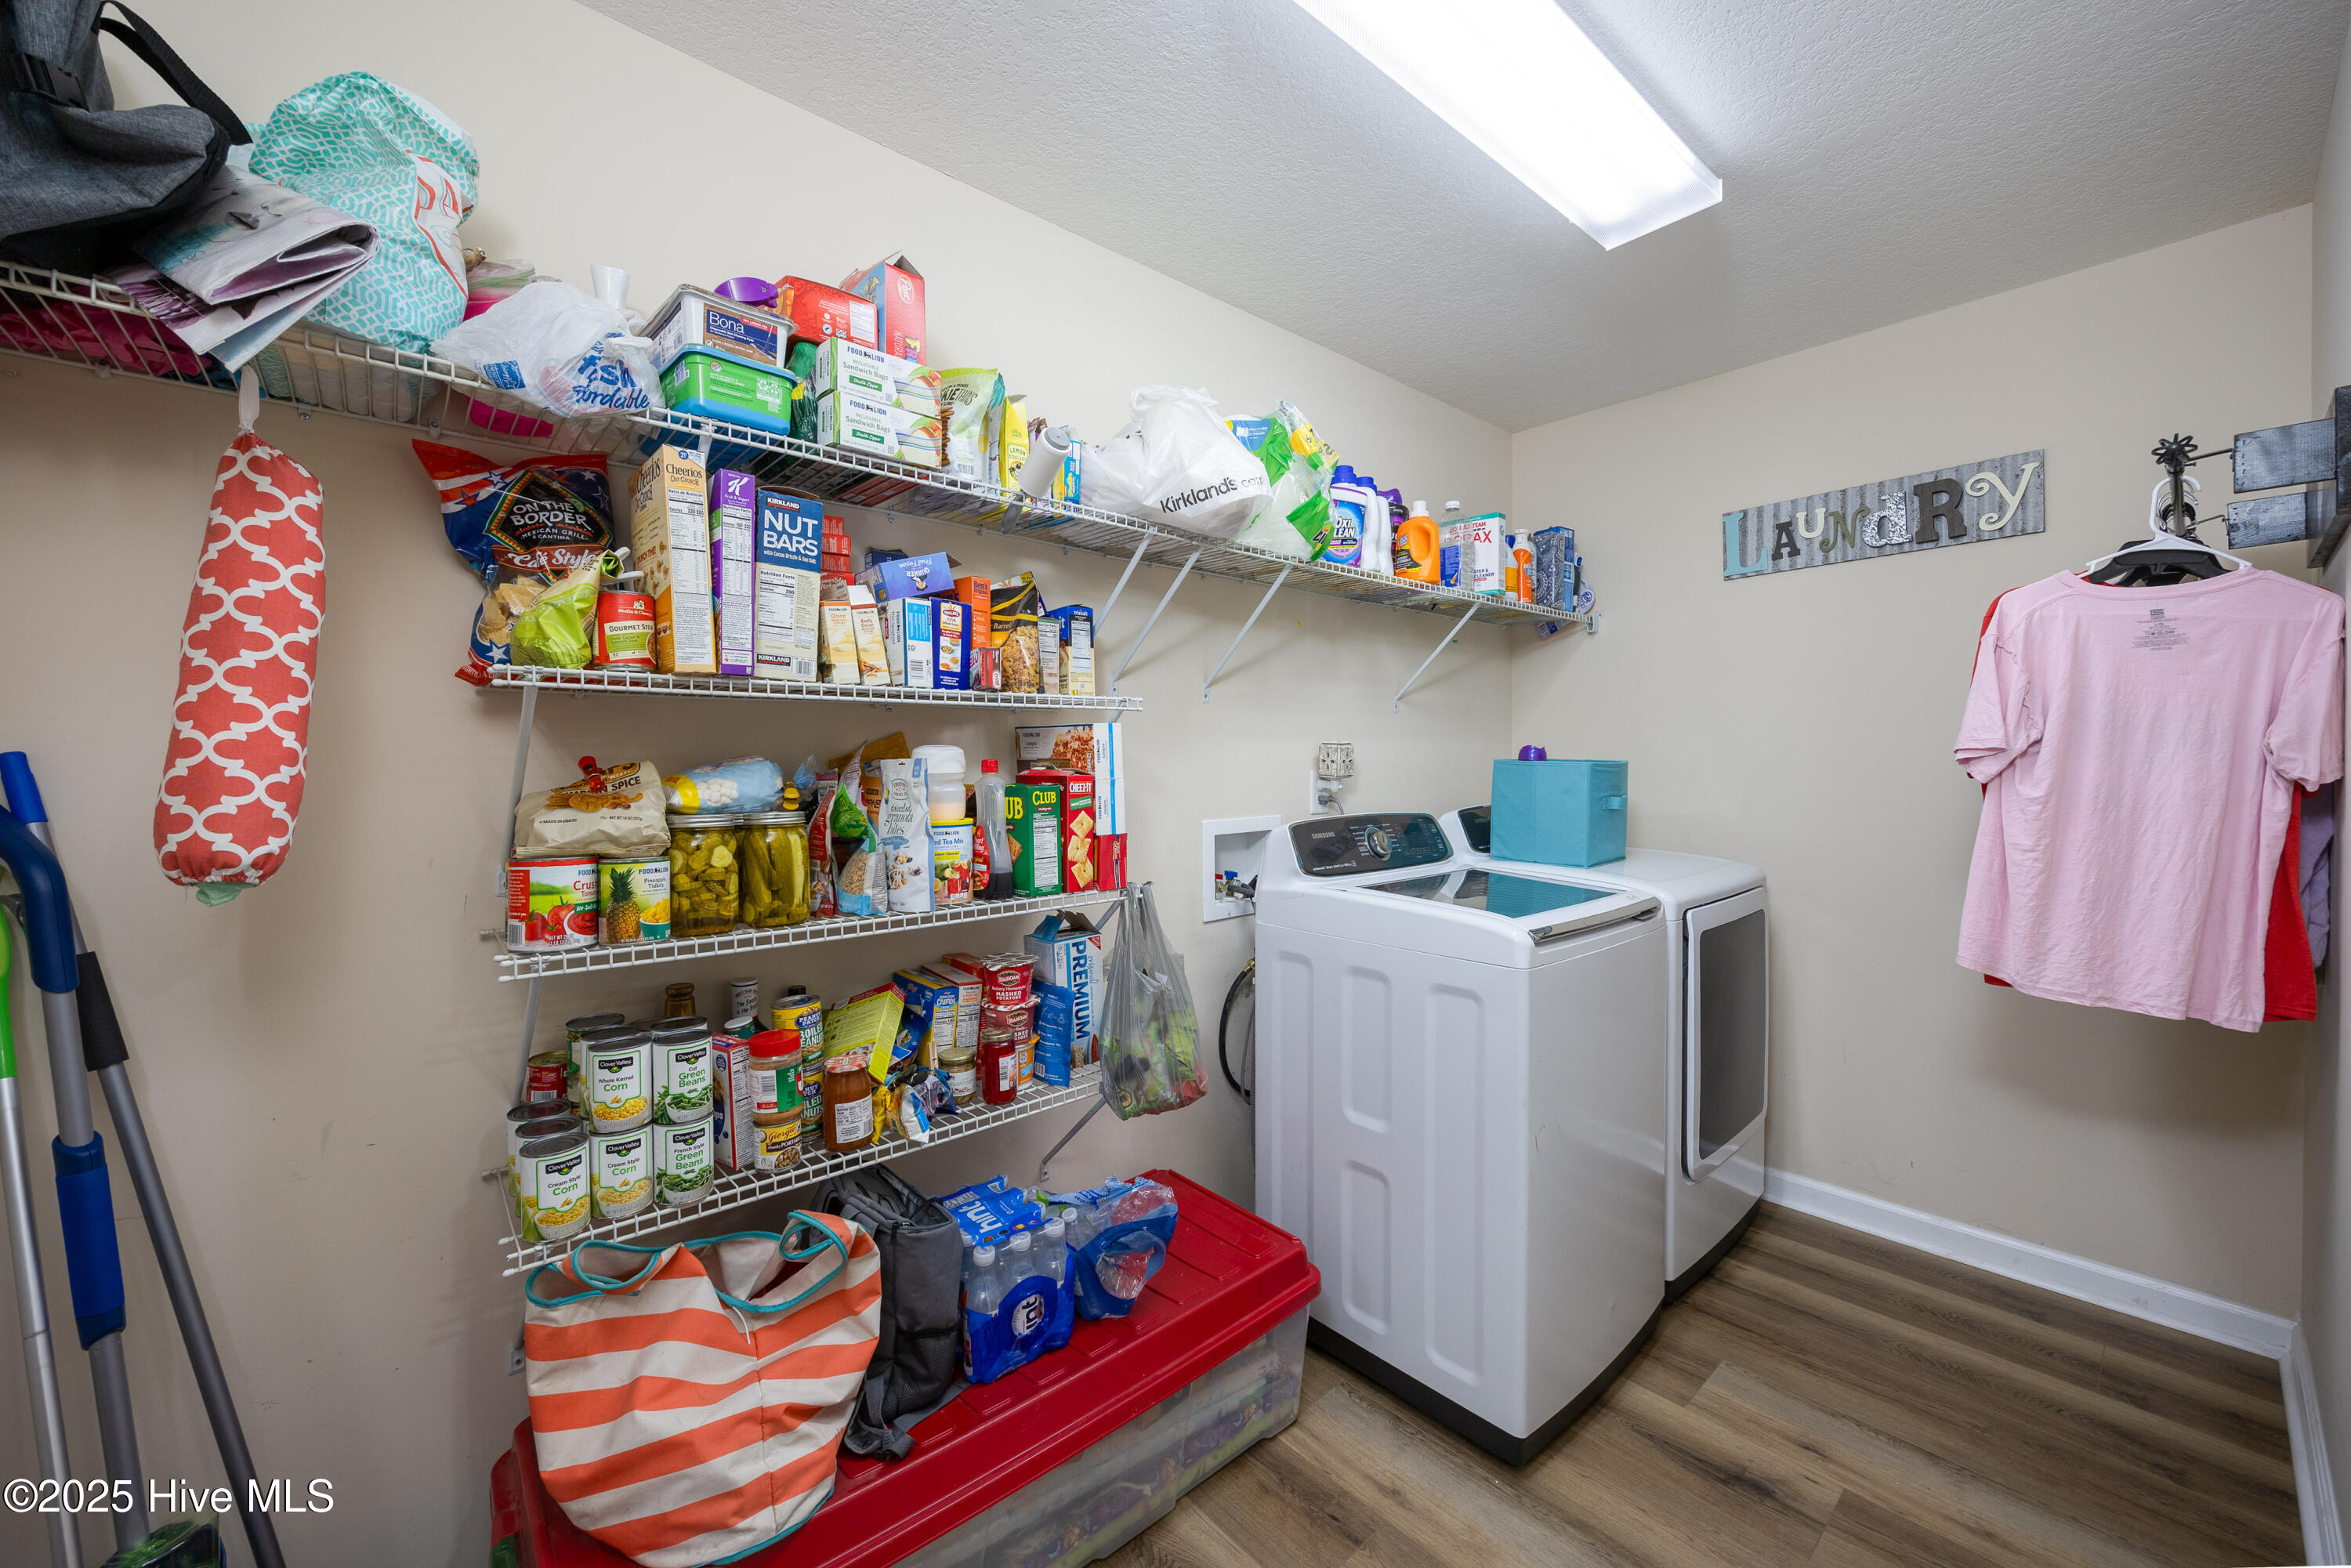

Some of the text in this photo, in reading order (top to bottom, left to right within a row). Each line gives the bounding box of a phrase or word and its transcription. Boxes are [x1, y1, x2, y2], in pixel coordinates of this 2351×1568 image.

[710, 311, 744, 334] Bona
[847, 346, 885, 363] FOOD LION
[842, 361, 889, 381] Sandwich Bags
[849, 400, 886, 416] FOOD LION
[846, 416, 891, 433] Sandwich Bags
[1009, 447, 1026, 456] LEMON
[637, 458, 661, 494] Cheerios
[666, 463, 703, 479] Cheerios
[728, 476, 750, 496] K
[513, 501, 575, 514] ON THE
[767, 497, 800, 509] KIRKLAND
[510, 510, 592, 531] BORDER
[764, 509, 819, 538] NUT
[1337, 516, 1352, 528] OXI
[521, 528, 585, 540] MEXICAN GRILL
[1333, 527, 1357, 538] LEAN
[763, 531, 819, 556] BARS
[552, 549, 596, 569] Style
[905, 567, 930, 578] QUAKER
[973, 580, 988, 590] Ben's
[758, 654, 791, 663] KIRKLAND
[611, 776, 642, 791] SPICE
[1069, 782, 1092, 793] CHEEZ-IT
[1032, 791, 1056, 806] CLUB
[890, 802, 912, 813] drizzled
[883, 812, 915, 827] granola
[886, 823, 904, 835] bites
[573, 880, 598, 891] Crush
[998, 974, 1020, 983] IDAHOAN
[1072, 940, 1091, 1040] PREMIUM
[936, 997, 956, 1007] Crumbs
[799, 1011, 820, 1023] PEANUT
[802, 1016, 820, 1026] PATCH
[1008, 1014, 1028, 1024] IDAHOAN
[691, 1050, 706, 1059] Valley
[678, 1068, 705, 1081] Green
[603, 1083, 629, 1092] Corn
[678, 1076, 706, 1088] Beans
[693, 1143, 705, 1151] Style
[675, 1150, 704, 1162] Green
[547, 1158, 581, 1171] Clover Valley
[611, 1164, 637, 1176] Corn
[676, 1158, 704, 1170] Beans
[547, 1174, 581, 1190] Cream Style
[552, 1182, 578, 1197] Corn
[958, 1200, 1003, 1234] hint
